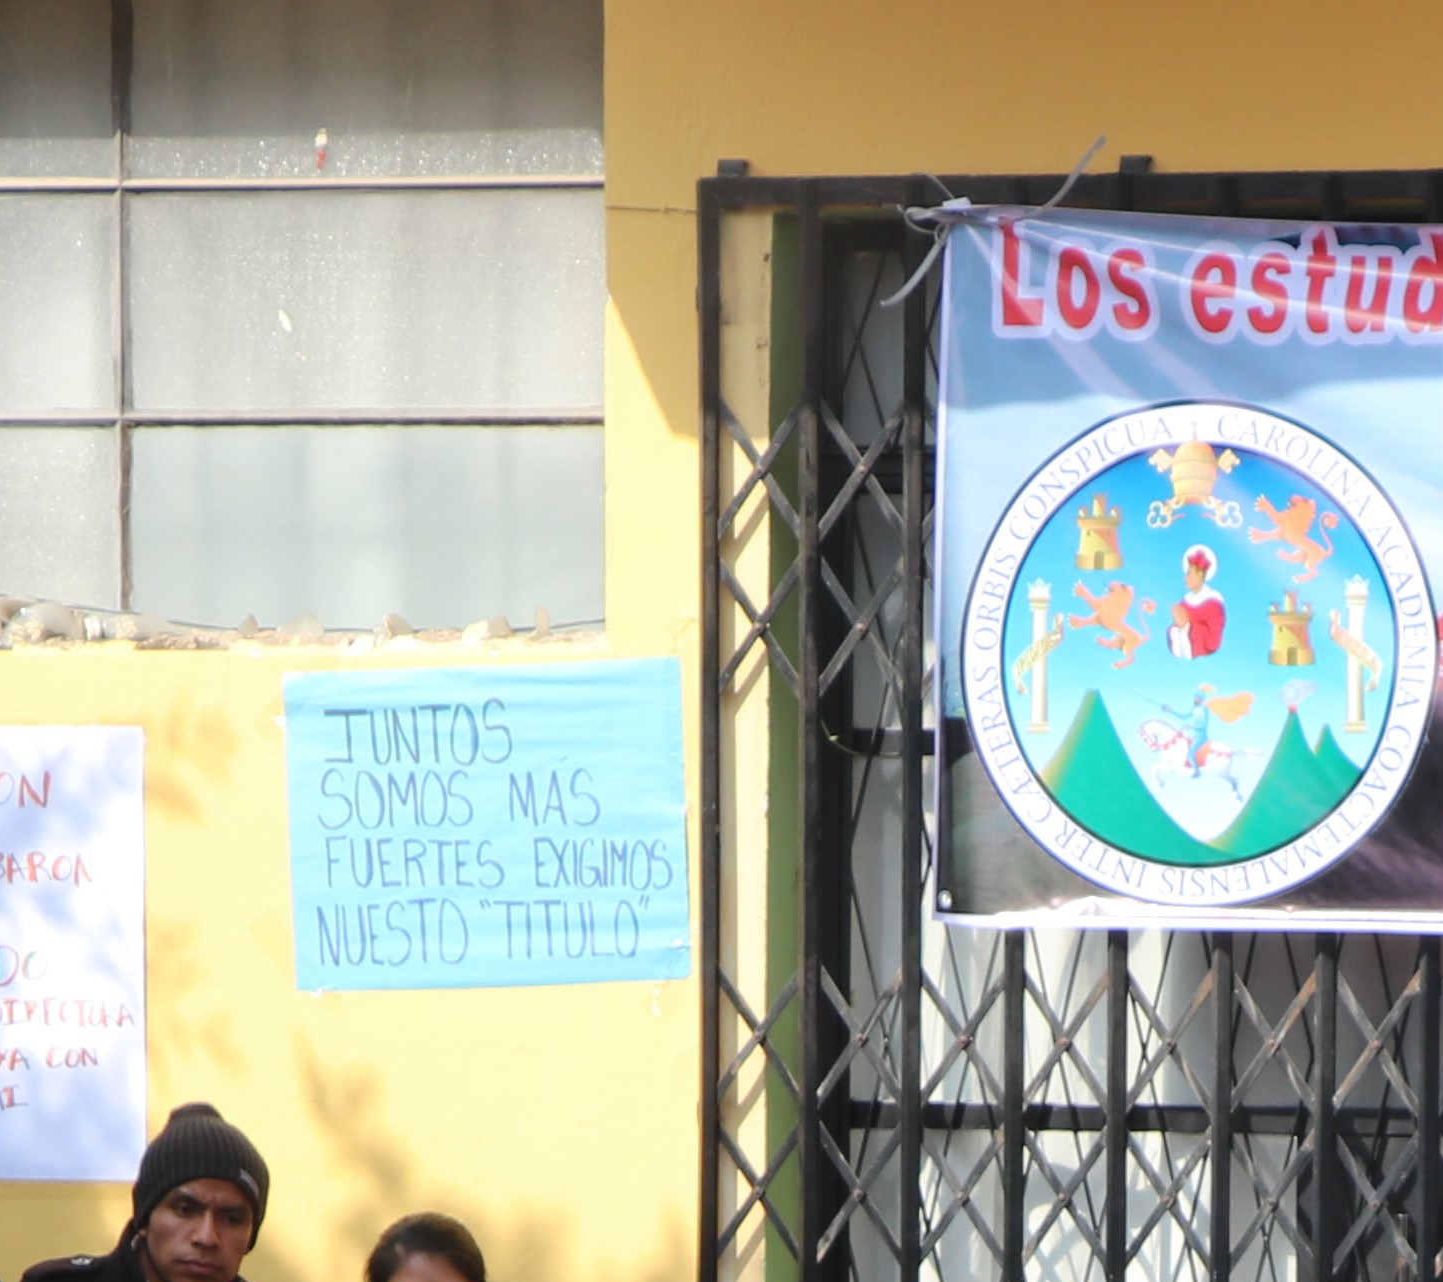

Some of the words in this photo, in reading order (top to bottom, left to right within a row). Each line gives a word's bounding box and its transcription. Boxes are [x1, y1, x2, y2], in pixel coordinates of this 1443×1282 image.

[1002, 224, 1149, 329] Los
[1003, 413, 1172, 544] CONSPICUA
[1216, 411, 1379, 519] CAROLINA
[971, 544, 1019, 650] ORBIS
[1366, 514, 1429, 716] ACADEMIA
[324, 697, 513, 765] JUNTOS
[317, 768, 474, 830] SOMOS
[1158, 723, 1417, 896] COACTEMALENSIS
[325, 836, 504, 889] FUERTES
[533, 837, 673, 890] EXIGIMOS
[1049, 815, 1148, 887] INTER
[317, 898, 469, 966] NUESTO
[46, 1046, 98, 1067] CON
